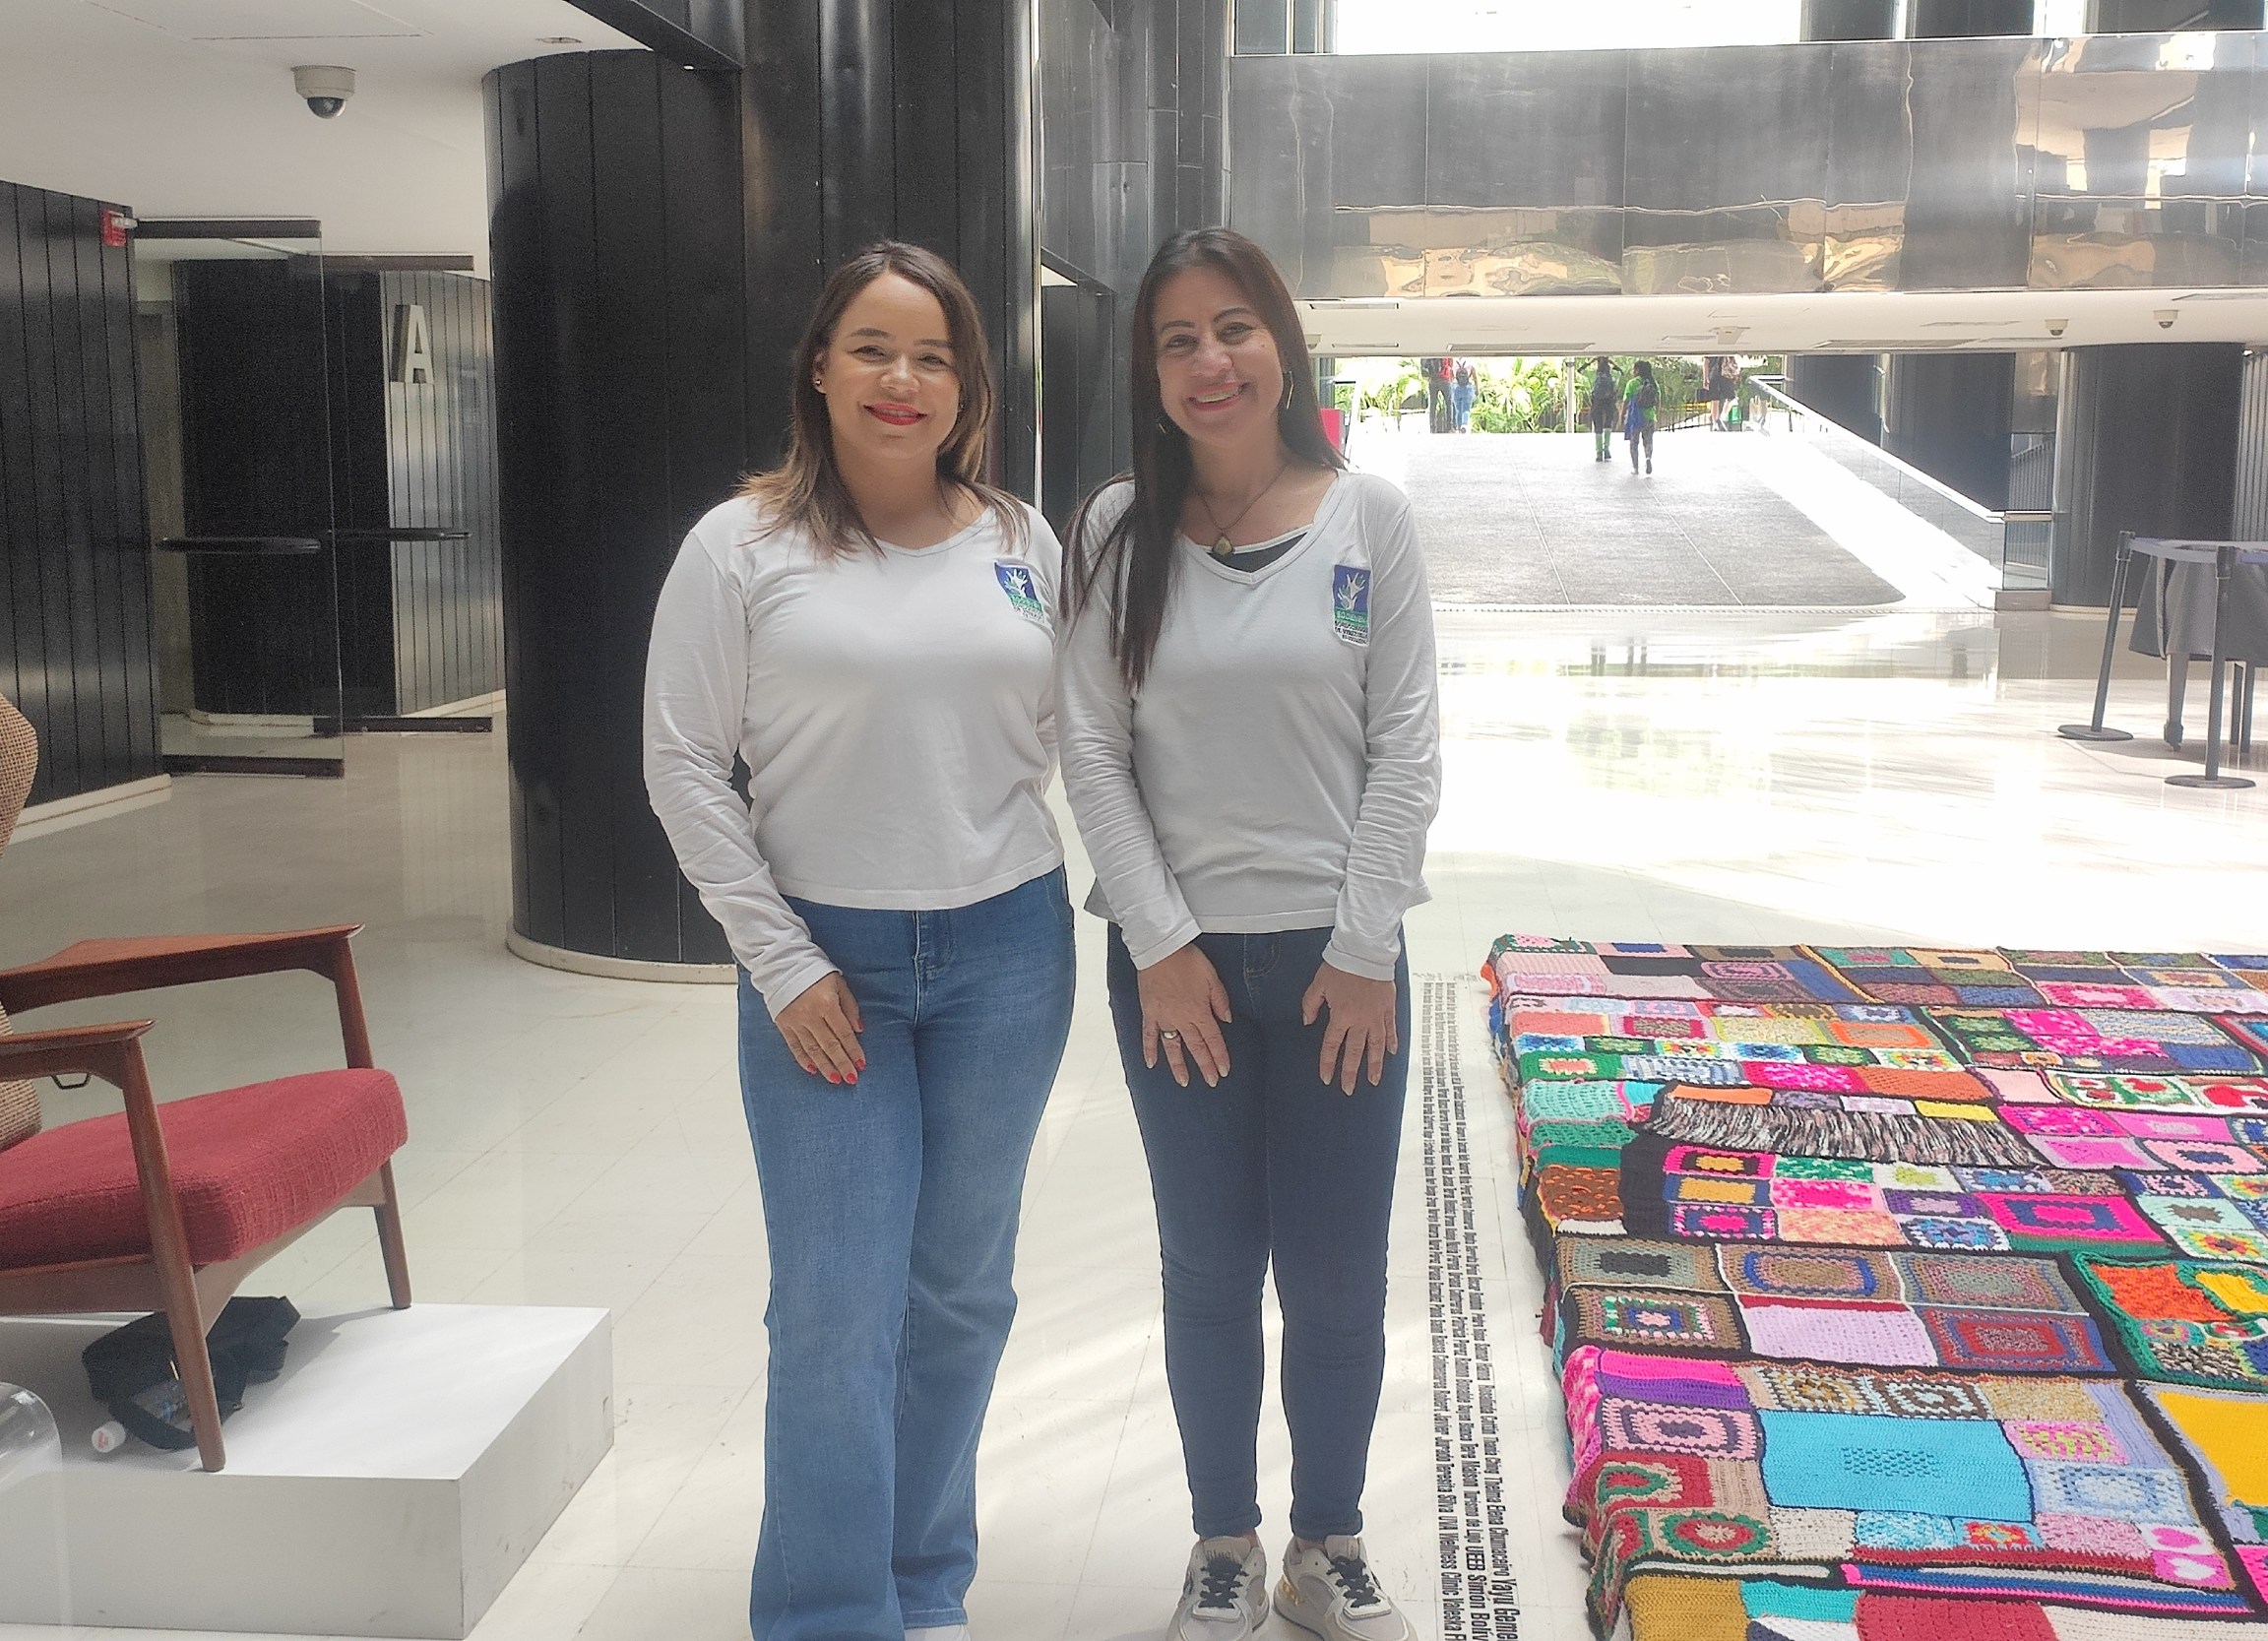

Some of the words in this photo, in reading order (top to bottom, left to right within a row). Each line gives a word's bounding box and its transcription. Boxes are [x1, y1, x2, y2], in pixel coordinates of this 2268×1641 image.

[404, 304, 434, 384] A
[1436, 1463, 1455, 1492] Teresita
[1484, 1478, 1504, 1503] Thelma
[1437, 1494, 1457, 1513] Silva
[1486, 1505, 1506, 1525] Elena
[1438, 1516, 1458, 1530] UVA
[1465, 1529, 1484, 1544] Lujo
[1439, 1533, 1460, 1569] Wellness
[1465, 1546, 1485, 1571] UEEB
[1488, 1528, 1512, 1576] Chumaceiro
[1441, 1572, 1463, 1596] Clinic
[1468, 1574, 1490, 1609] Simón
[1487, 1579, 1517, 1605] Yayu
[1442, 1598, 1466, 1631] Valeska
[1471, 1612, 1494, 1641] Bolív
[1493, 1608, 1520, 1641] Geme
